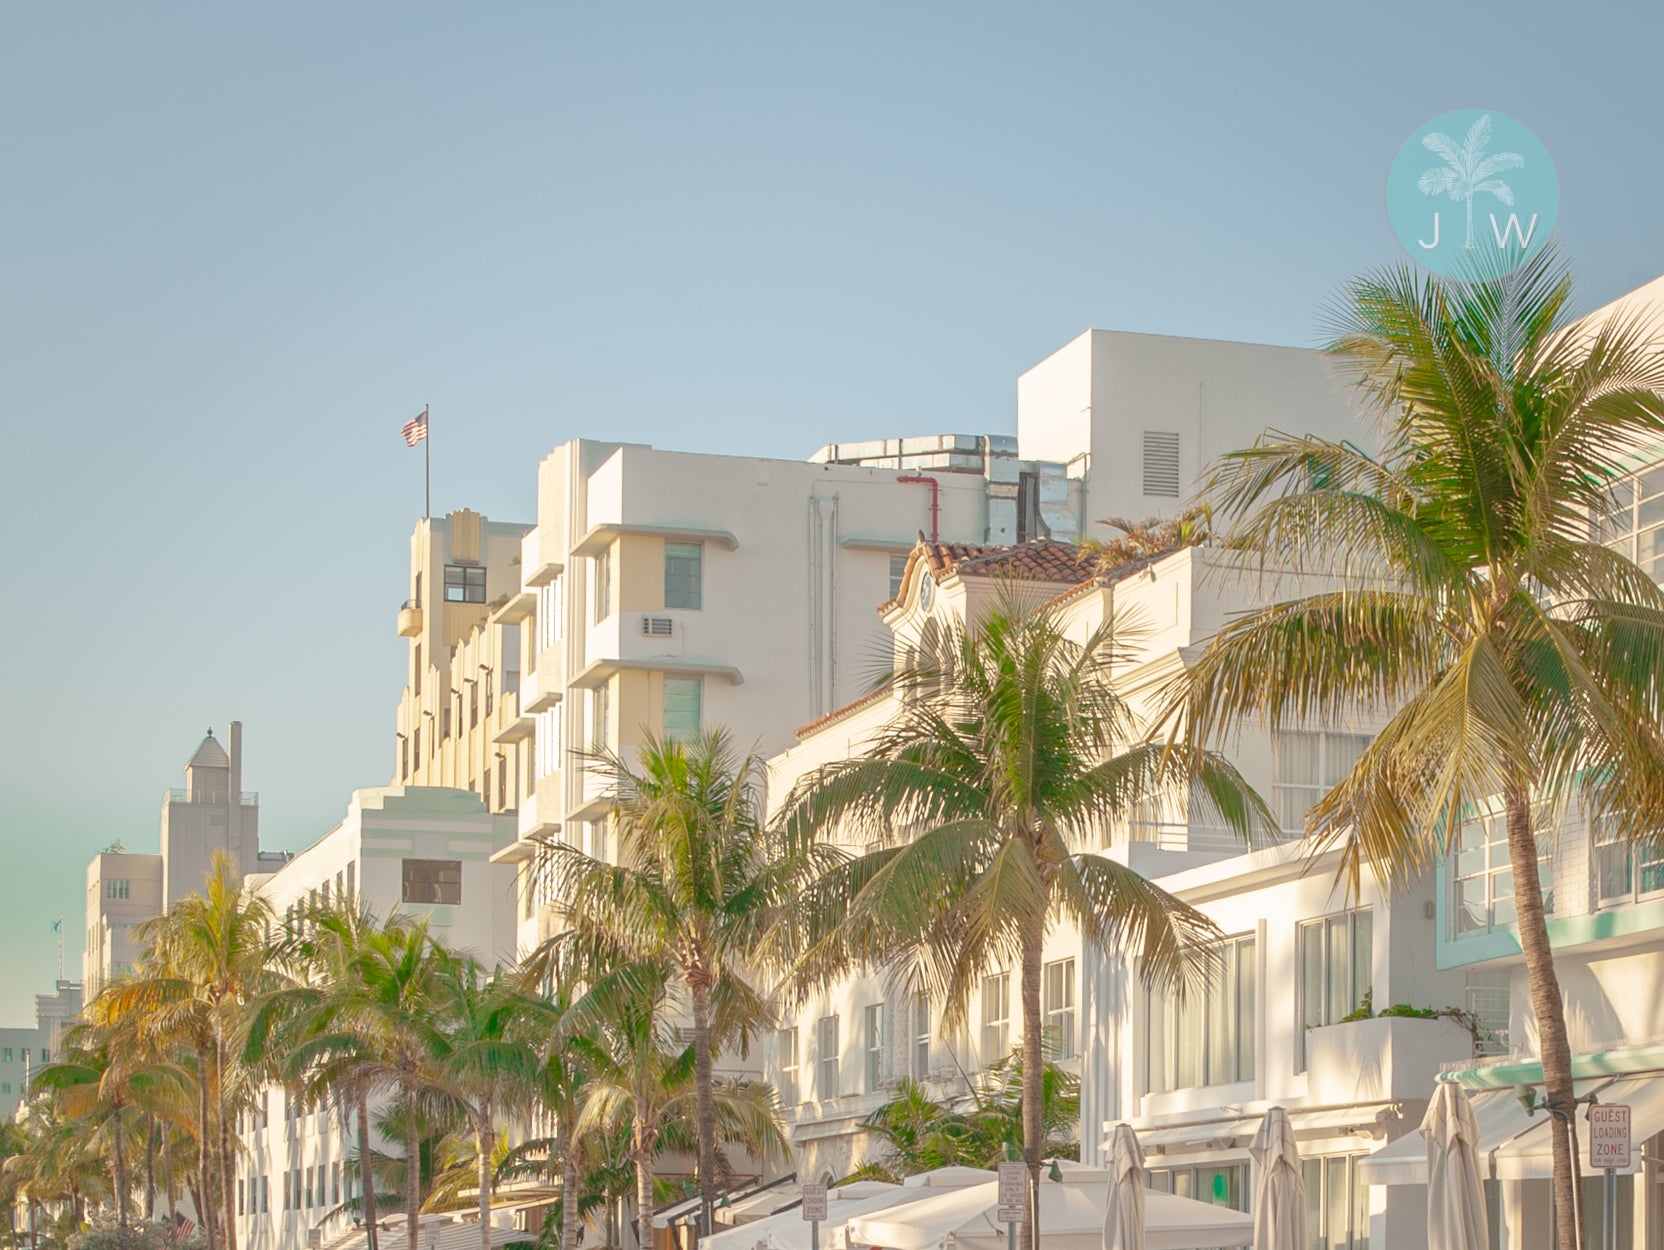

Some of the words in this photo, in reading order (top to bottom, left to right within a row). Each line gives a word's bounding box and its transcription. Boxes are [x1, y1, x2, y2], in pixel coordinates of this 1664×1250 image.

[1594, 1110, 1627, 1122] GUEST
[1593, 1127, 1627, 1139] LOADING
[1597, 1143, 1624, 1156] ZONE
